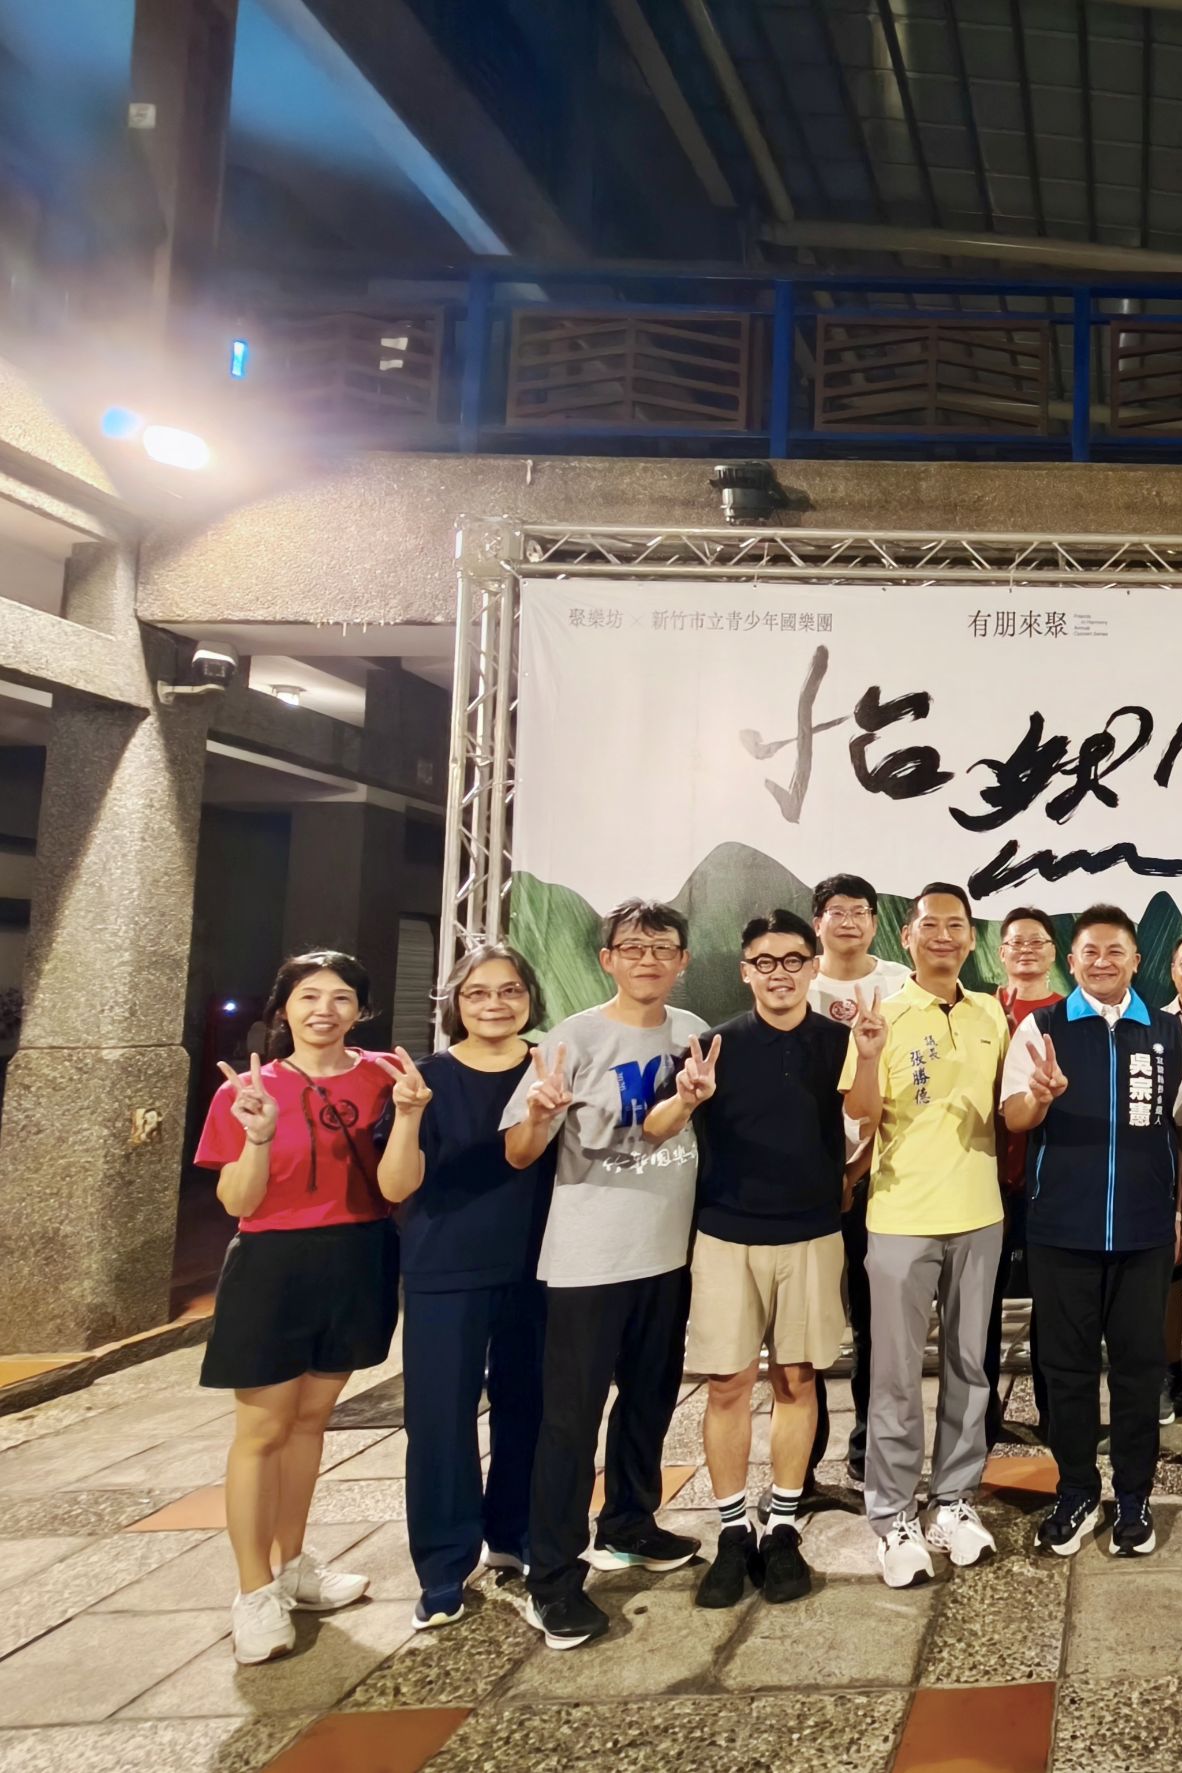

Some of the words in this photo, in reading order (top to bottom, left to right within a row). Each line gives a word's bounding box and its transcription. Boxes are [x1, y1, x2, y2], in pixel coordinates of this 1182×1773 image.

[568, 607, 624, 630] 聚樂坊
[652, 609, 834, 634] 新竹市立青少年國樂團
[967, 609, 1069, 639] 有朋來聚
[1128, 1052, 1153, 1128] 吳宗憲
